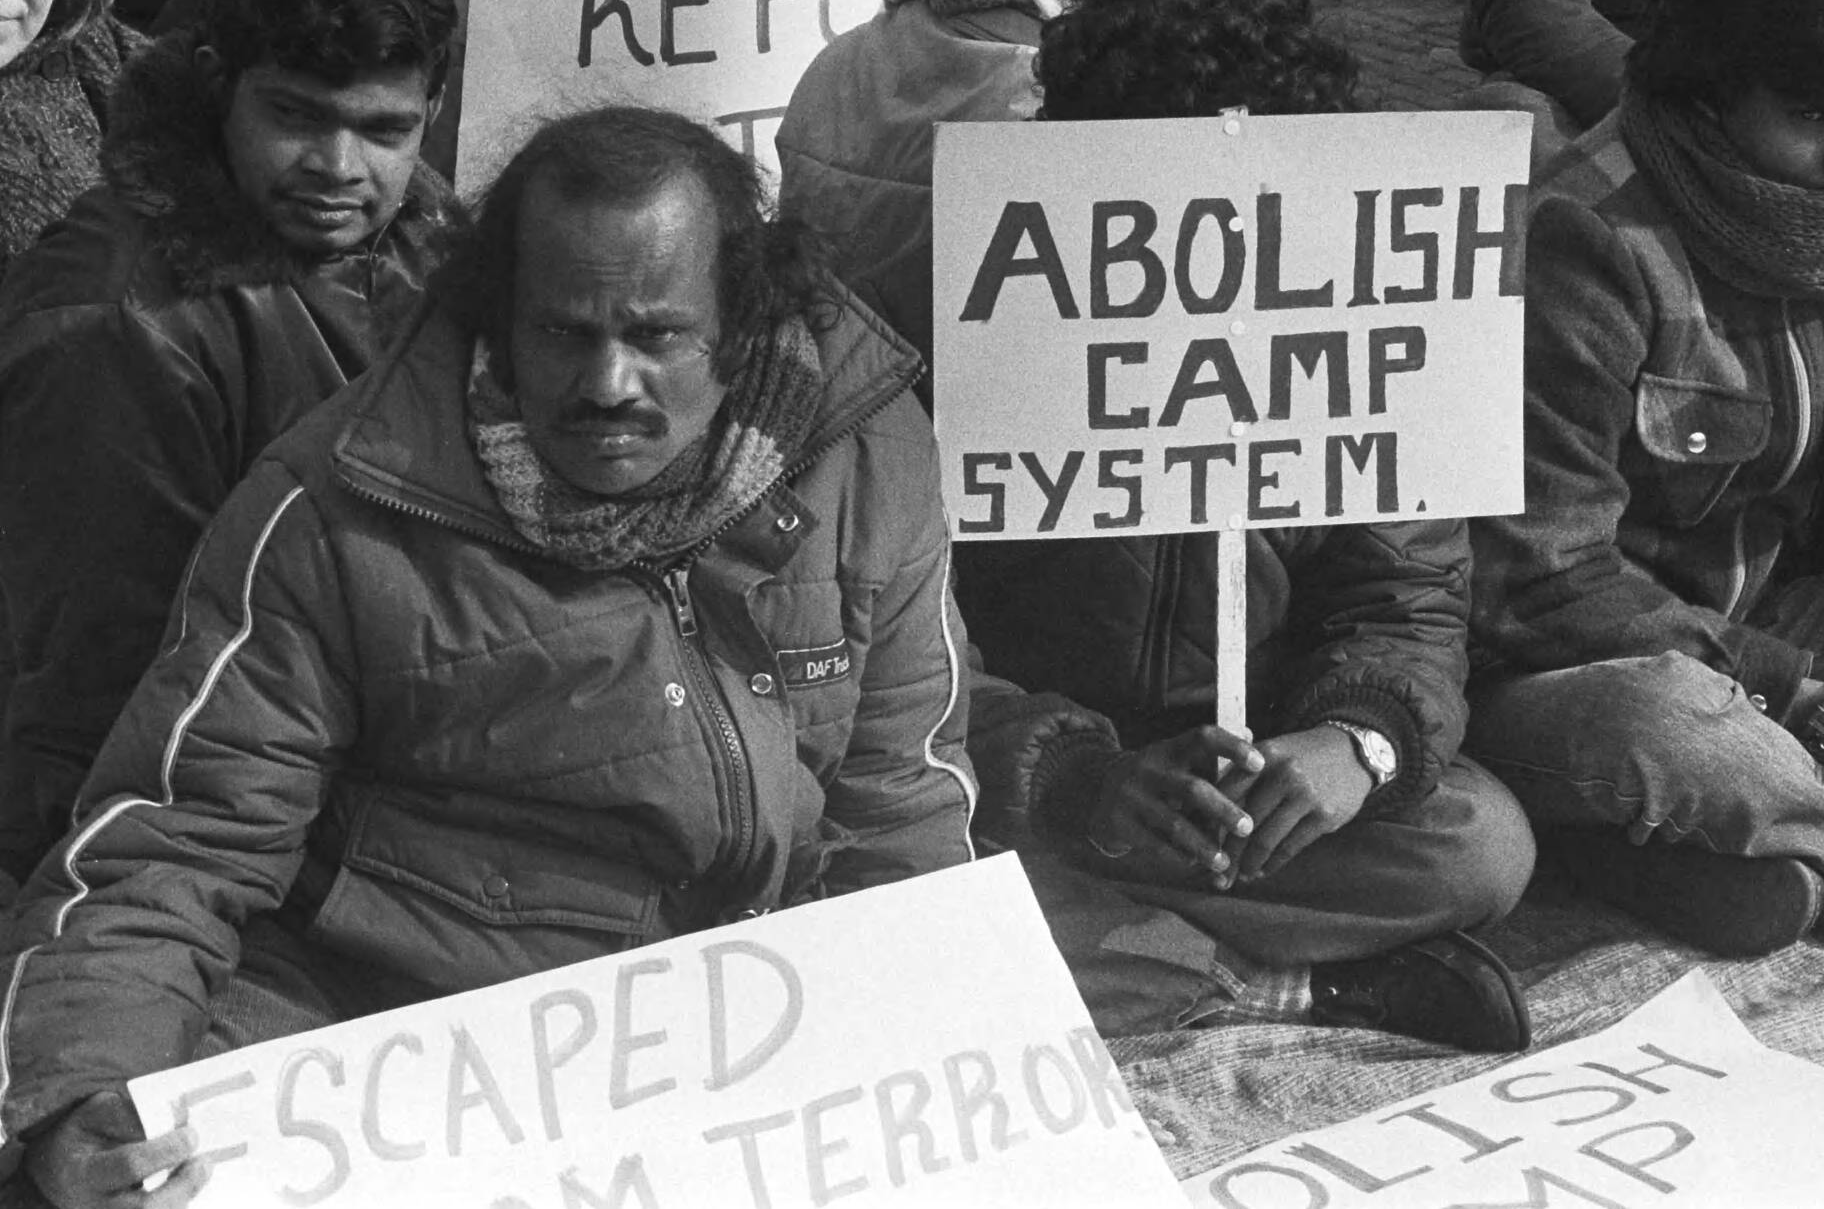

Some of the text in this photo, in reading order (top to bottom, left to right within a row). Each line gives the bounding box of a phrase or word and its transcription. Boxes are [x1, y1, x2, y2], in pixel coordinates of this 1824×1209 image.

[958, 184, 1529, 322] ABOLISH
[1087, 326, 1427, 430] CAMP
[958, 432, 1428, 533] SYSTEM.
[807, 659, 833, 680] DAF
